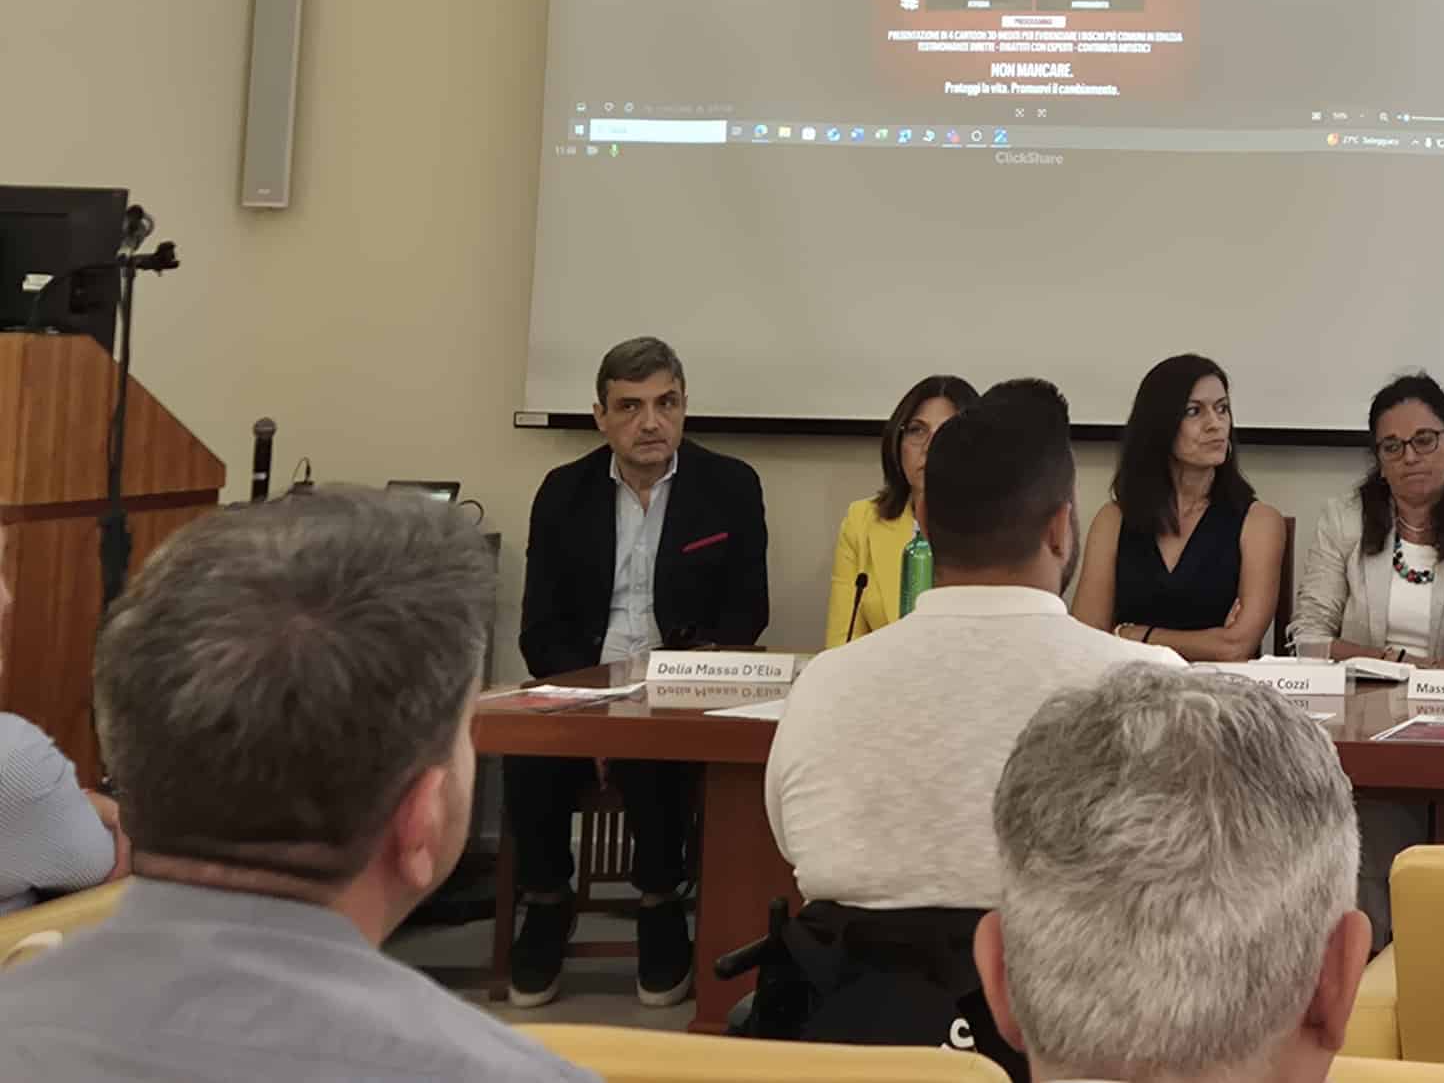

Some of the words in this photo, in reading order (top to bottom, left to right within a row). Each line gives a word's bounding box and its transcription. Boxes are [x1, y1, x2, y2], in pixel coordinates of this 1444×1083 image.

[990, 62, 1015, 78] NON
[1016, 62, 1074, 78] MANCARE.
[944, 81, 981, 96] Proteggi
[994, 150, 1064, 166] ClickShare
[657, 662, 692, 676] Delia
[695, 663, 739, 676] Massa
[742, 664, 782, 677] D'Elia
[1277, 677, 1310, 690] Cozzi
